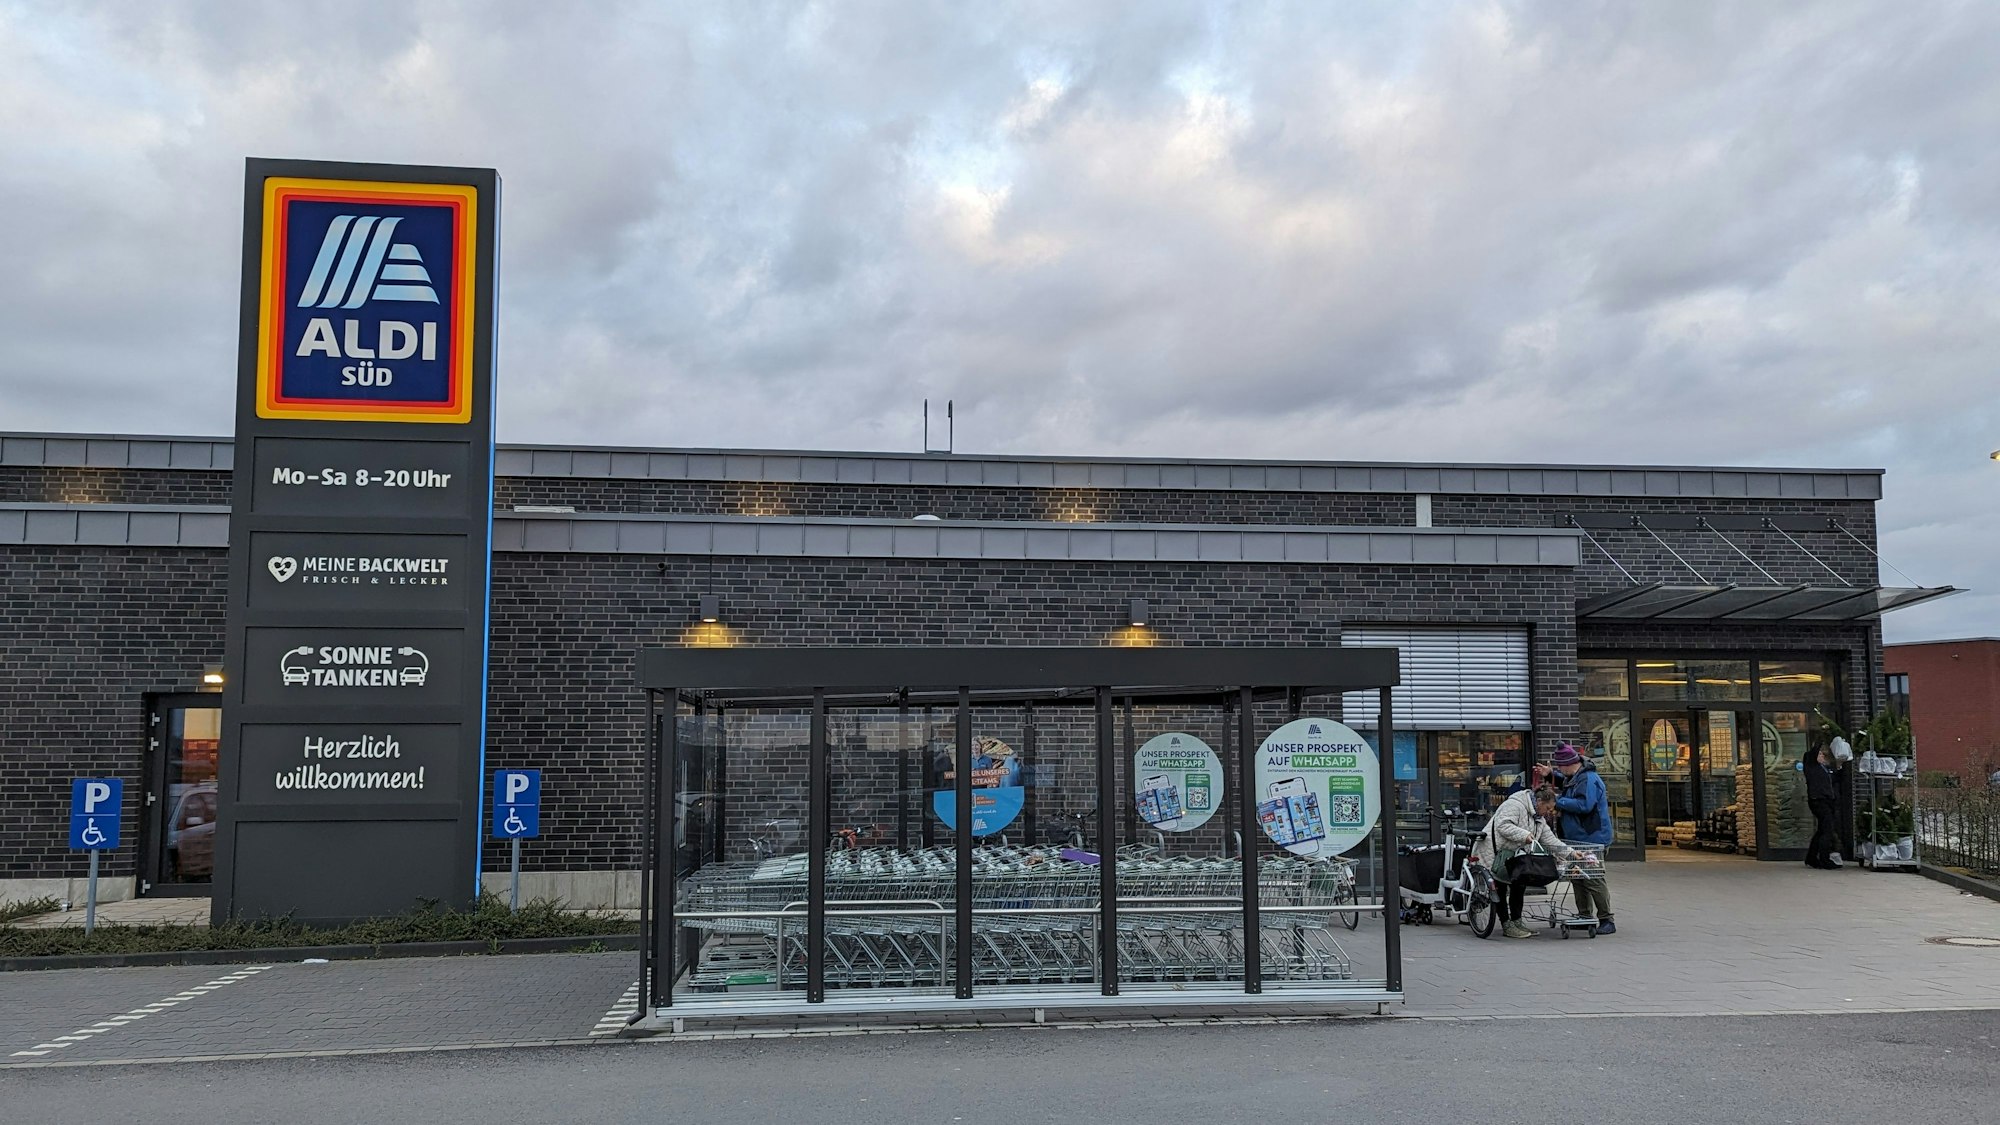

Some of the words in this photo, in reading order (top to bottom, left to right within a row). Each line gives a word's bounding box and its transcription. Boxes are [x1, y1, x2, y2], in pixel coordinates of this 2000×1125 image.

[295, 317, 437, 361] ALDI
[341, 361, 393, 386] SÜD
[413, 469, 452, 488] Uhr
[303, 557, 356, 572] MEINE
[358, 558, 449, 573] BACKWELT
[303, 576, 360, 584] FRISCH
[370, 577, 379, 585] &
[389, 577, 449, 585] LECKER
[318, 646, 393, 665] SONNE
[311, 668, 398, 687] TANKEN
[303, 734, 401, 759] Herzlich
[1141, 750, 1168, 758] UNSER
[1170, 750, 1210, 758] PROSPEKT
[1267, 743, 1304, 753] UNSER
[1307, 743, 1363, 753] PROSPEKT
[1268, 756, 1290, 766] AUF
[1293, 756, 1355, 766] WHATSAPP.
[275, 764, 425, 789] willkommen!
[506, 773, 530, 803] P
[85, 783, 110, 813] P
